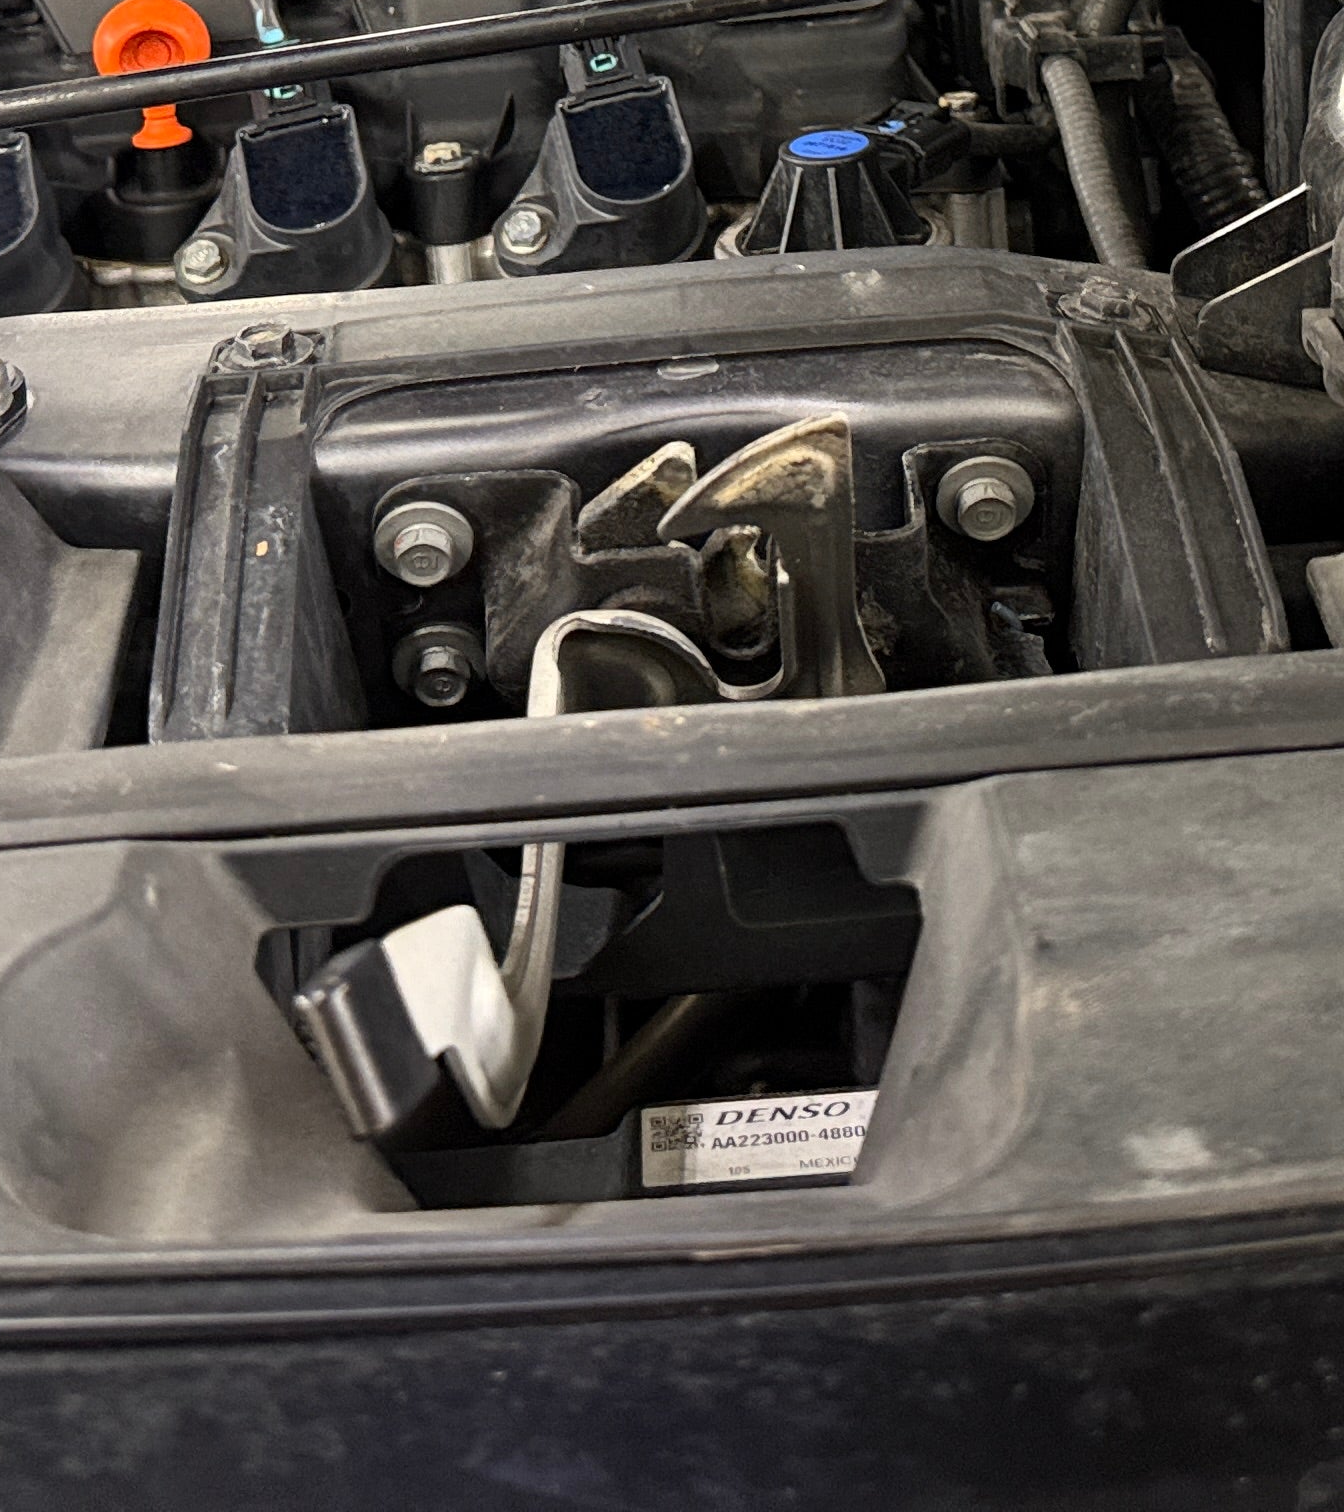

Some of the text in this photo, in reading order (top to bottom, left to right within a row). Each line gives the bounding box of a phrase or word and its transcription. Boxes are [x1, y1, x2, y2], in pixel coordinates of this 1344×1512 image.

[716, 1101, 851, 1126] DENSO
[711, 1125, 866, 1150] AA223000-4880
[799, 1155, 858, 1170] MEXIC
